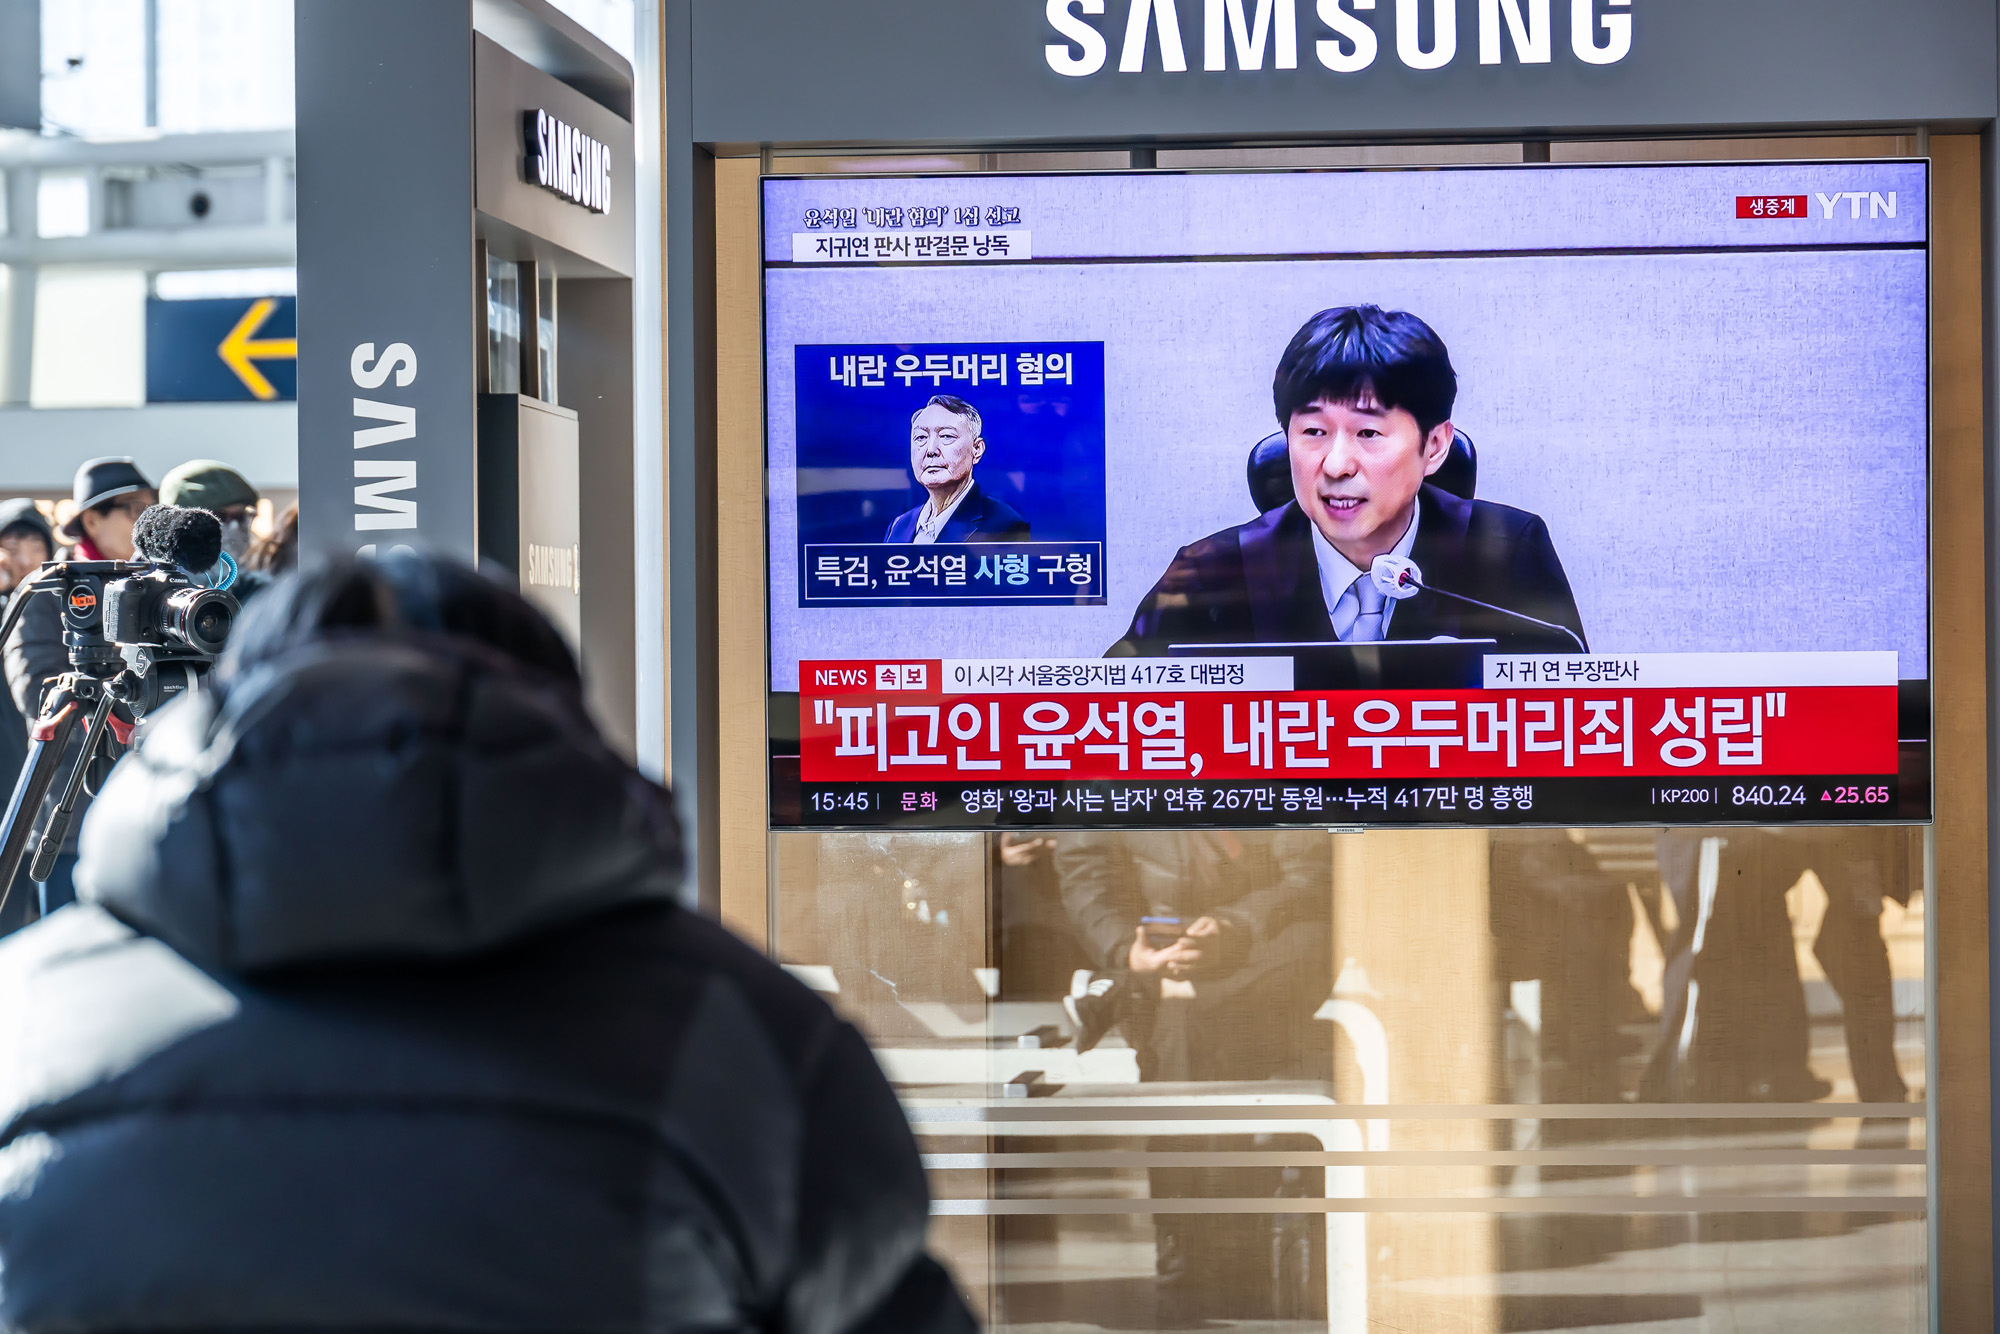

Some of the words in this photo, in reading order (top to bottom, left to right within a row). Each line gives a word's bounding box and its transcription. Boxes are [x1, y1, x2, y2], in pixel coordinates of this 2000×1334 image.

[1045, 0, 1632, 77] SAMSUNG
[537, 108, 611, 215] SAMSUNG
[954, 205, 980, 226] 1심
[984, 204, 1021, 227] 선고
[1750, 198, 1795, 215] 생중계
[1814, 191, 1897, 219] YTN
[816, 236, 869, 258] 지귀연
[874, 236, 911, 257] 판사
[914, 235, 969, 257] 판결문
[973, 235, 1010, 256] 낭독
[830, 354, 887, 387] 내란
[893, 353, 1007, 387] 우두머리
[1016, 352, 1072, 386] 혐의
[350, 342, 418, 562] SAM
[529, 543, 573, 588] SAMSUNG
[815, 556, 878, 588] 특검,
[884, 555, 966, 586] 윤석열
[974, 554, 1029, 585] 사형
[1037, 553, 1092, 585] 구형
[815, 669, 867, 687] NEWS
[954, 665, 971, 686] 이
[977, 665, 1014, 686] 시각
[1018, 664, 1125, 686] 서울중앙지법
[1131, 664, 1185, 685] 417호
[1190, 663, 1245, 685] 대법정
[1565, 660, 1640, 682] 부장판사
[814, 700, 1001, 772] "피고인
[1018, 699, 1203, 777] 윤석열,
[1223, 699, 1334, 770] 내란
[1347, 696, 1634, 769] 우두머리죄
[1650, 692, 1786, 768] 성립"
[811, 791, 869, 812] 15:45
[900, 790, 938, 812] 문화
[961, 789, 1004, 813] 영화
[1009, 788, 1057, 812] '왕과
[1062, 788, 1105, 812] 사는
[1110, 788, 1157, 812] 남자'
[1163, 787, 1206, 812] 연휴
[1212, 787, 1275, 811] 267만
[1394, 786, 1458, 810] 417만
[1464, 785, 1484, 810] 명
[1490, 785, 1533, 810] 흥행
[1661, 788, 1709, 803] KP200
[1732, 785, 1806, 805] 840.24
